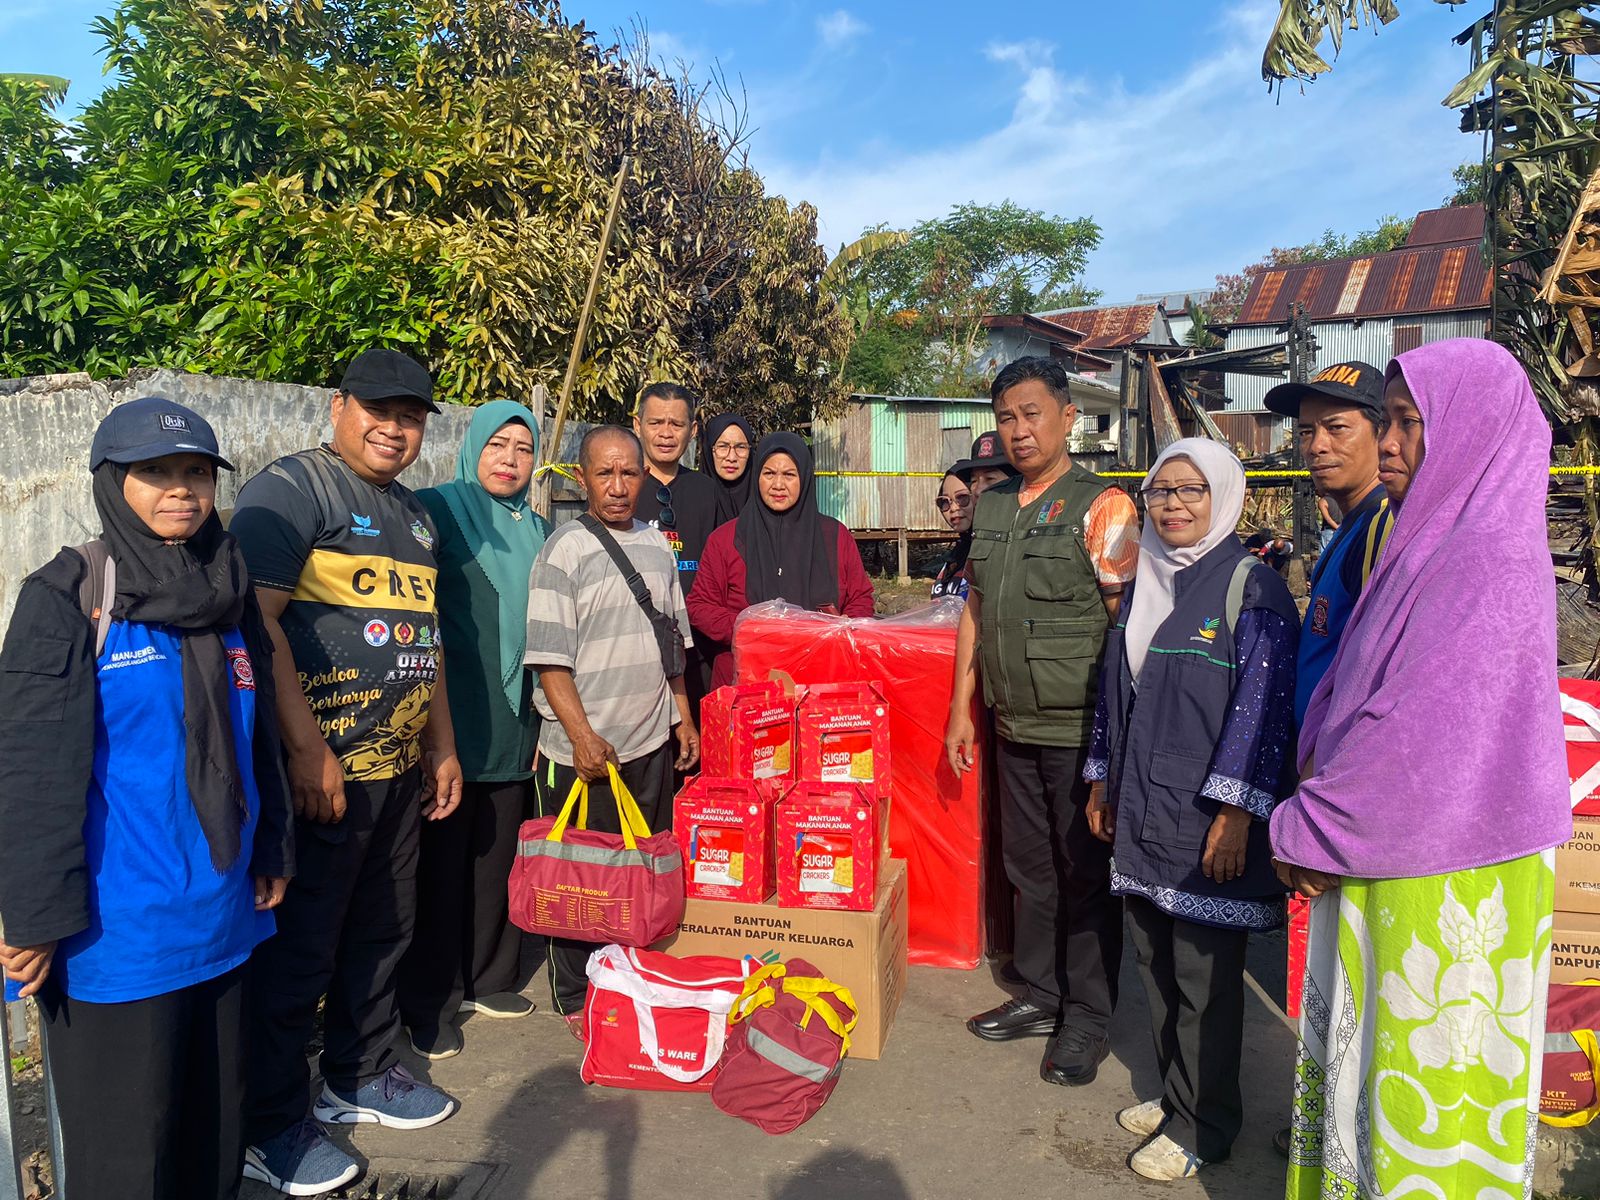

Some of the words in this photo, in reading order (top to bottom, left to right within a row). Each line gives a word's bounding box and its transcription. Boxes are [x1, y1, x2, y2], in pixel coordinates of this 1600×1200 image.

[297, 666, 360, 693] Berdoa
[305, 688, 384, 712] Berkarya
[761, 708, 784, 718] BANTUAN
[830, 714, 862, 722] BANTUAN
[753, 715, 778, 725] MAKANAN
[819, 721, 852, 729] MAKANAN
[822, 751, 851, 766] SUGAR
[702, 807, 735, 816] BANTUAN
[690, 813, 724, 822] MAKANAN
[832, 822, 852, 830] ANAK
[700, 846, 729, 862] SUGAR
[802, 853, 834, 868] SUGAR
[802, 871, 831, 880] CRACKERS
[555, 883, 581, 893] DAFTAR
[733, 915, 792, 930] BANTUAN
[744, 929, 786, 942] DAPUR
[788, 933, 855, 949] KELUARGA
[1551, 943, 1600, 955] ANTUA
[667, 1050, 698, 1061] WARE
[1546, 1090, 1568, 1099] KIT
[1540, 1099, 1577, 1107] ANTUAN
